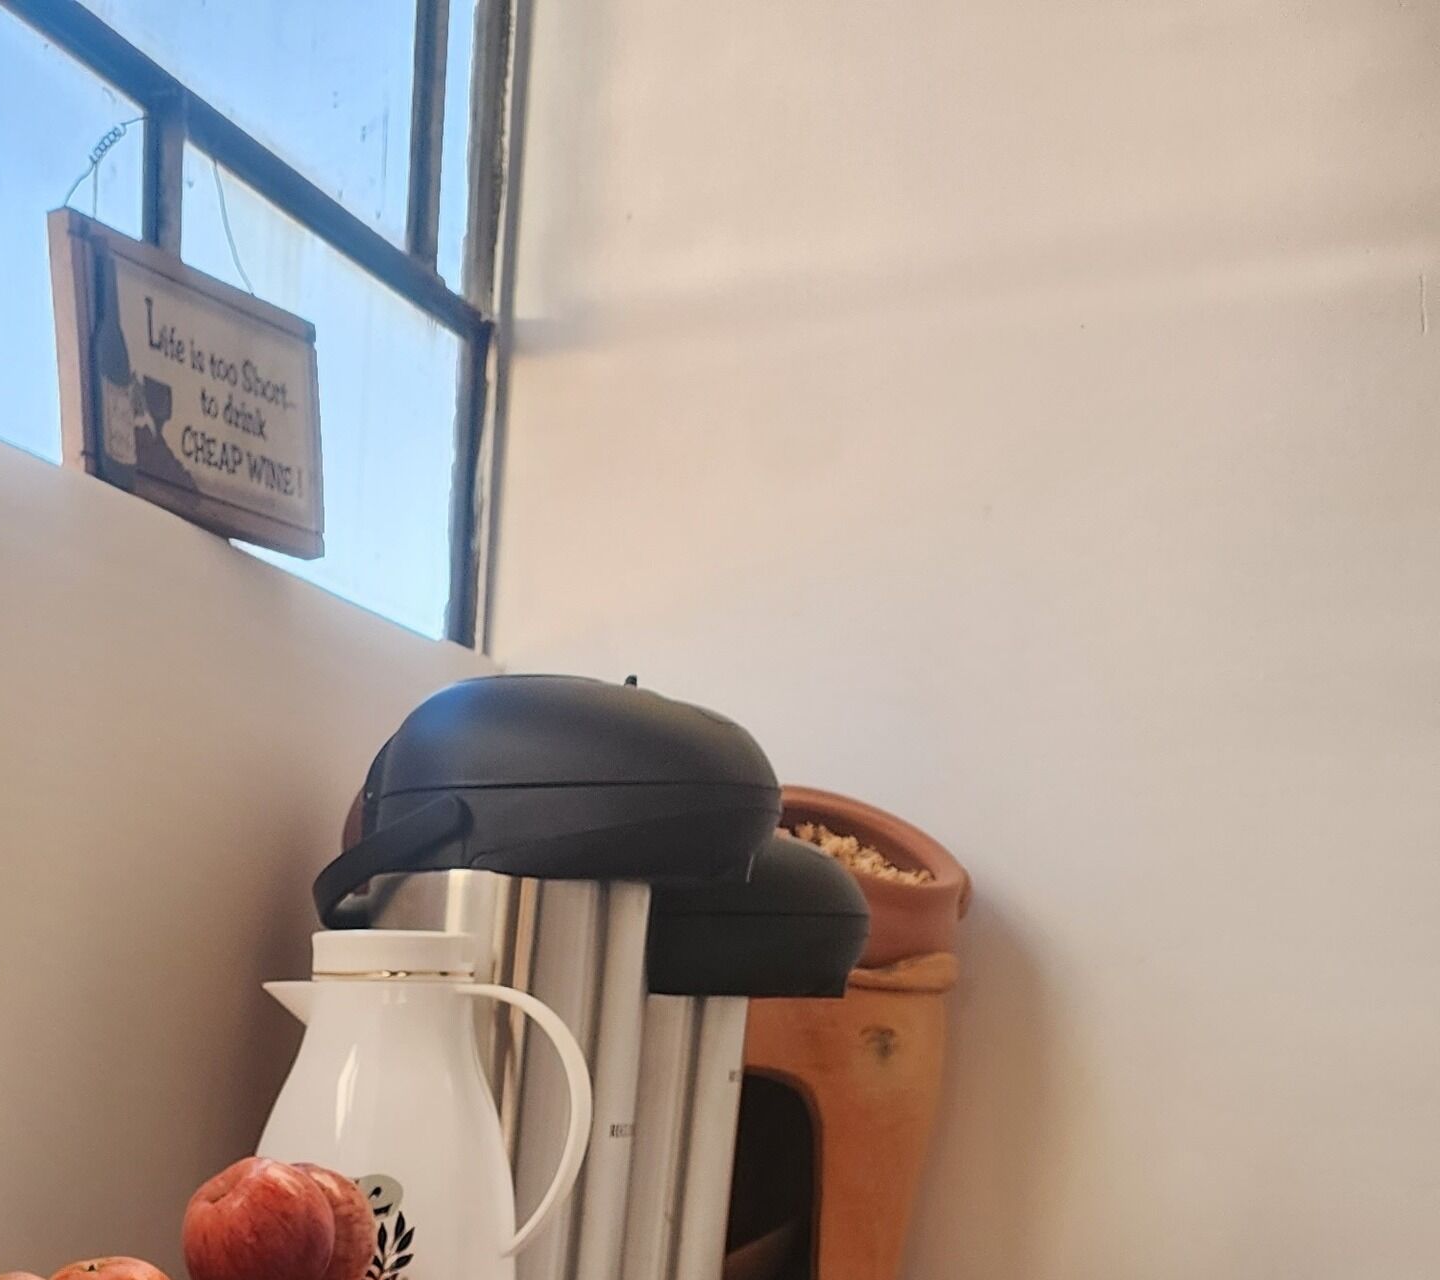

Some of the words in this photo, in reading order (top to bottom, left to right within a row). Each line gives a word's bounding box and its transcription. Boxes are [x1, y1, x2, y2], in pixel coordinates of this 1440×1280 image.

[210, 353, 238, 387] too
[201, 388, 218, 418] to
[181, 425, 242, 474] CHEAP
